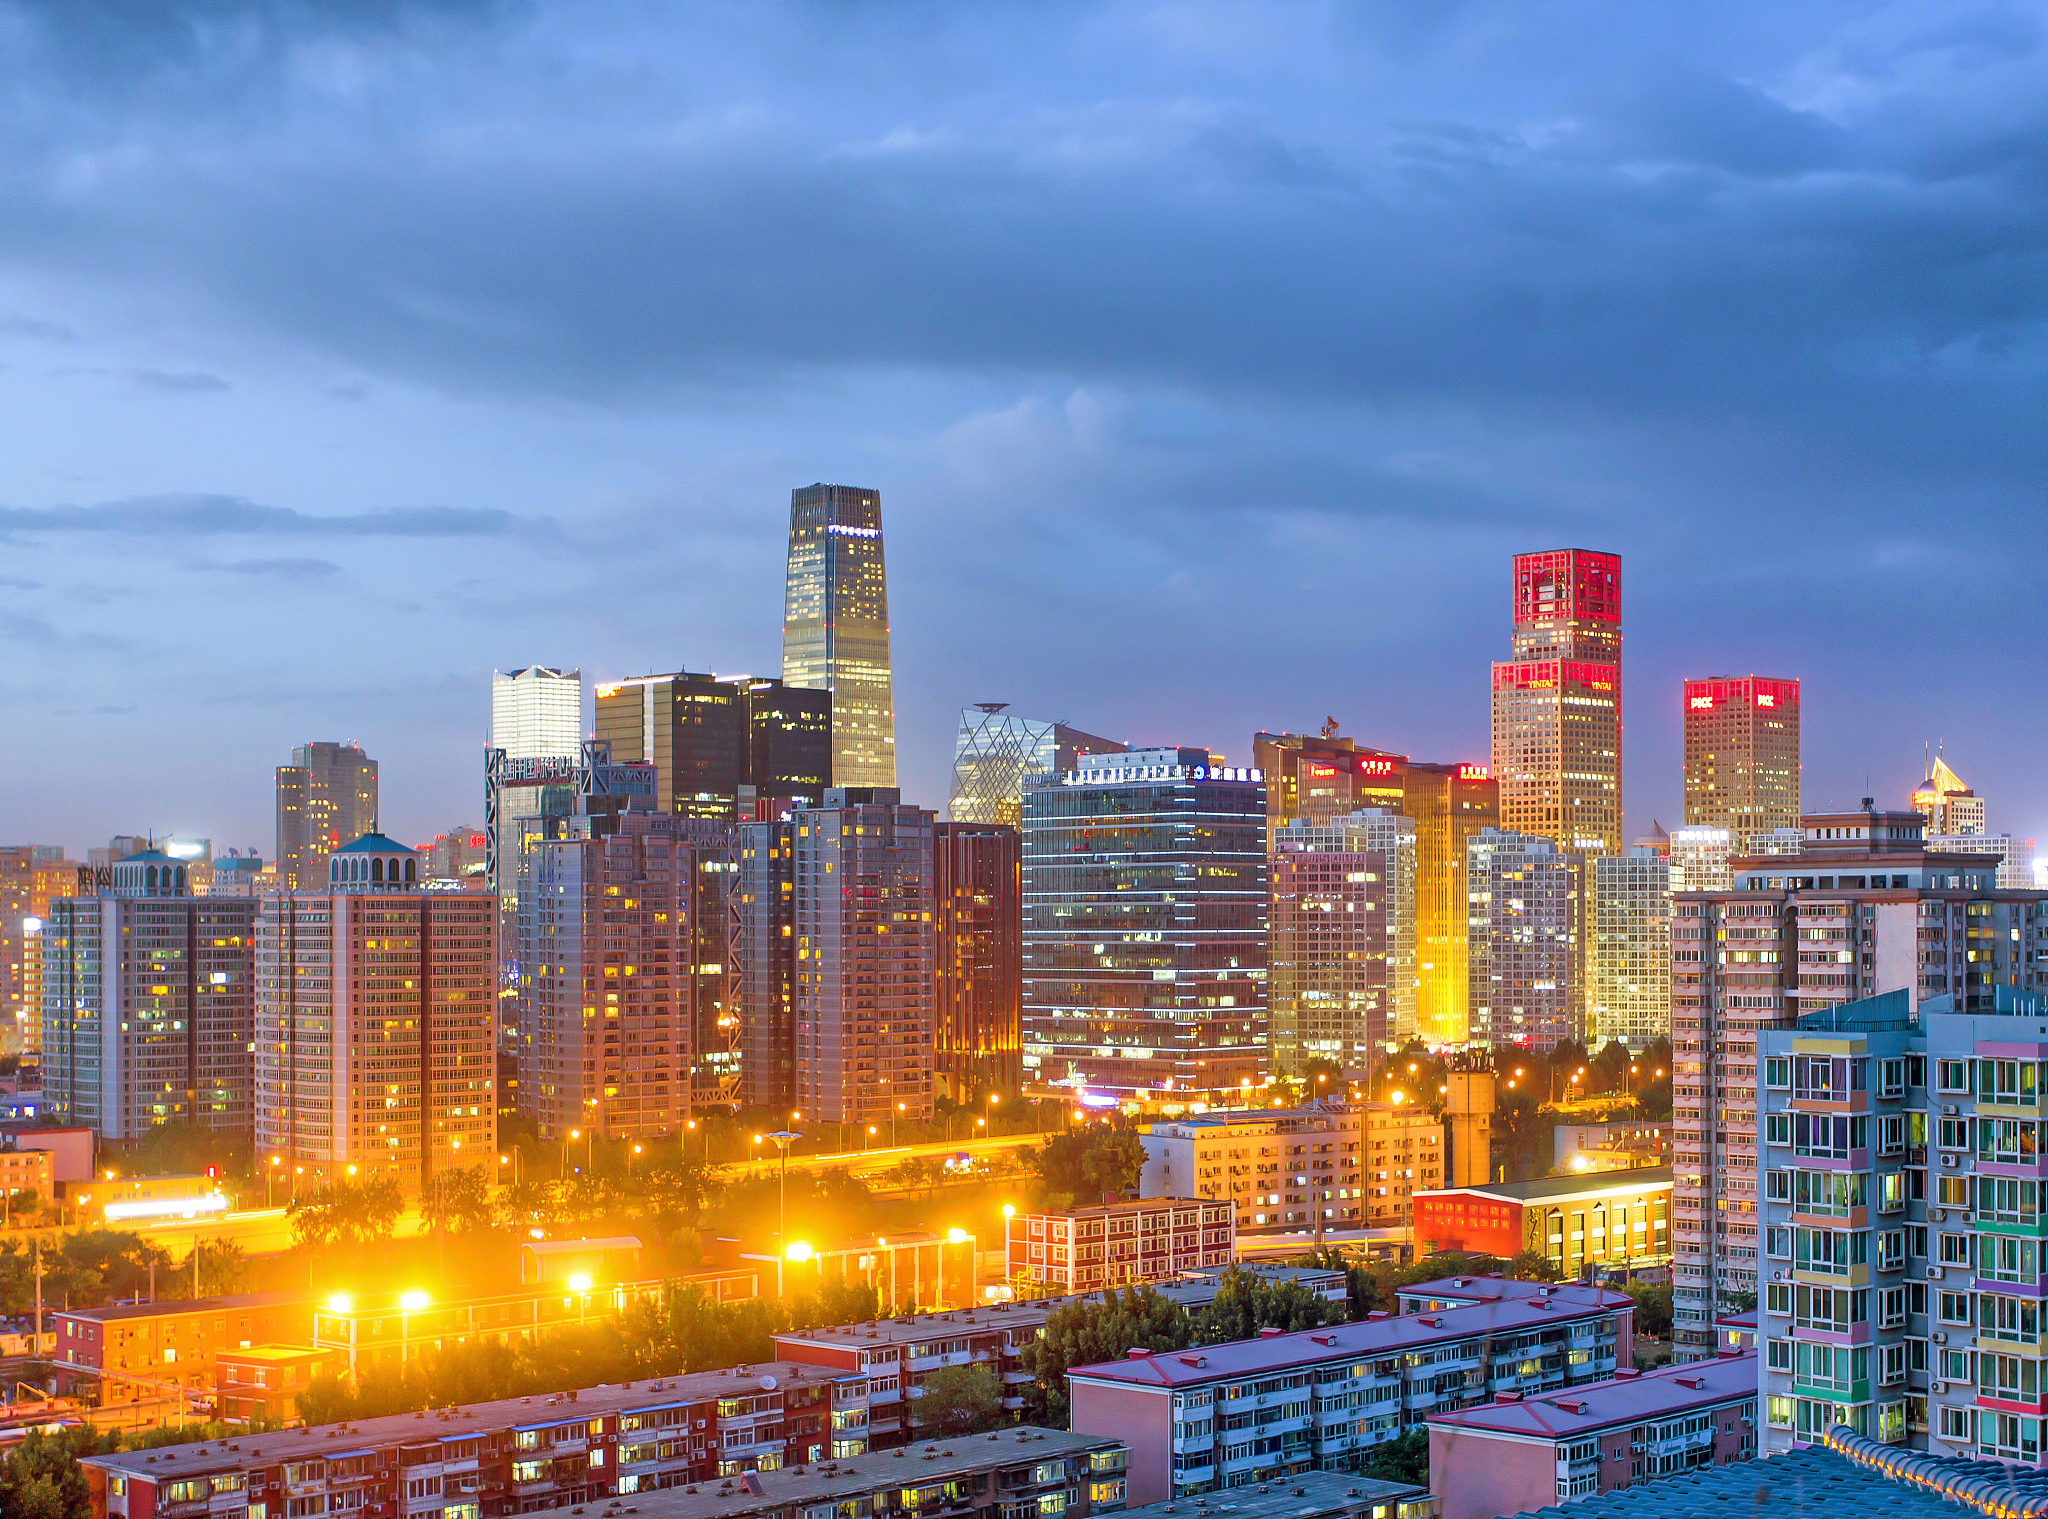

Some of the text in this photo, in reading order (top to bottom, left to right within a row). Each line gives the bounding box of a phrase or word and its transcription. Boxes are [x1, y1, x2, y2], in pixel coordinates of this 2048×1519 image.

[1528, 678, 1553, 689] YINTAI
[1591, 680, 1612, 691] YINTAI
[1690, 696, 1713, 709] PICC
[1757, 694, 1774, 707] PICC
[1321, 726, 1331, 737] SK
